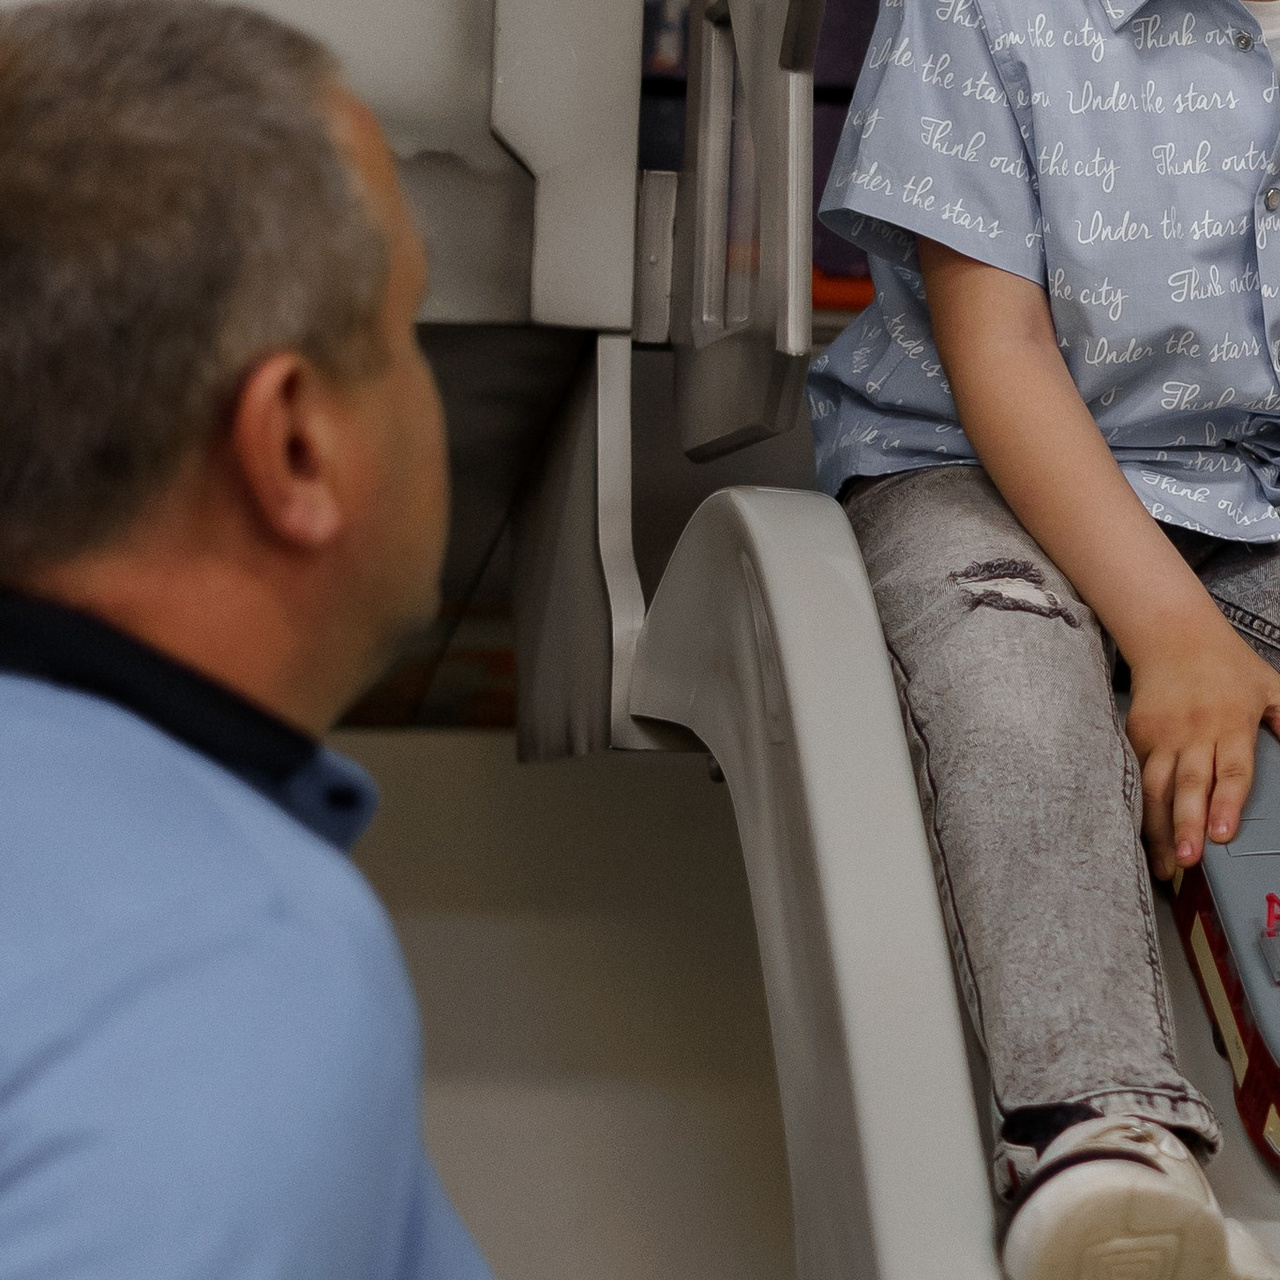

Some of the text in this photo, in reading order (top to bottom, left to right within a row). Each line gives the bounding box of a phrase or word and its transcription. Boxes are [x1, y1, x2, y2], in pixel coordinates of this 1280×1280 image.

[1027, 13, 1056, 48] the
[1063, 18, 1108, 63] city
[1131, 12, 1197, 50] Think
[922, 53, 956, 89] the
[962, 71, 1010, 107] star
[1066, 80, 1139, 115] Under
[1140, 80, 1166, 114] the
[1173, 82, 1240, 114] stars
[920, 116, 987, 163] Think
[1151, 140, 1212, 176] Think
[1221, 140, 1271, 171] outs
[1037, 141, 1070, 177] the
[1074, 147, 1122, 194] city
[902, 175, 936, 212] the
[940, 198, 1004, 239] stars
[1074, 210, 1154, 245] Under
[1160, 205, 1185, 240] the
[1190, 209, 1250, 241] stars
[1080, 276, 1130, 322] city
[1167, 264, 1226, 303] Think
[1084, 337, 1154, 368] Under
[1165, 330, 1202, 358] the
[1208, 332, 1263, 363] stars
[1160, 381, 1235, 411] Think
[1183, 451, 1246, 473] stars
[1140, 470, 1211, 504] Think
